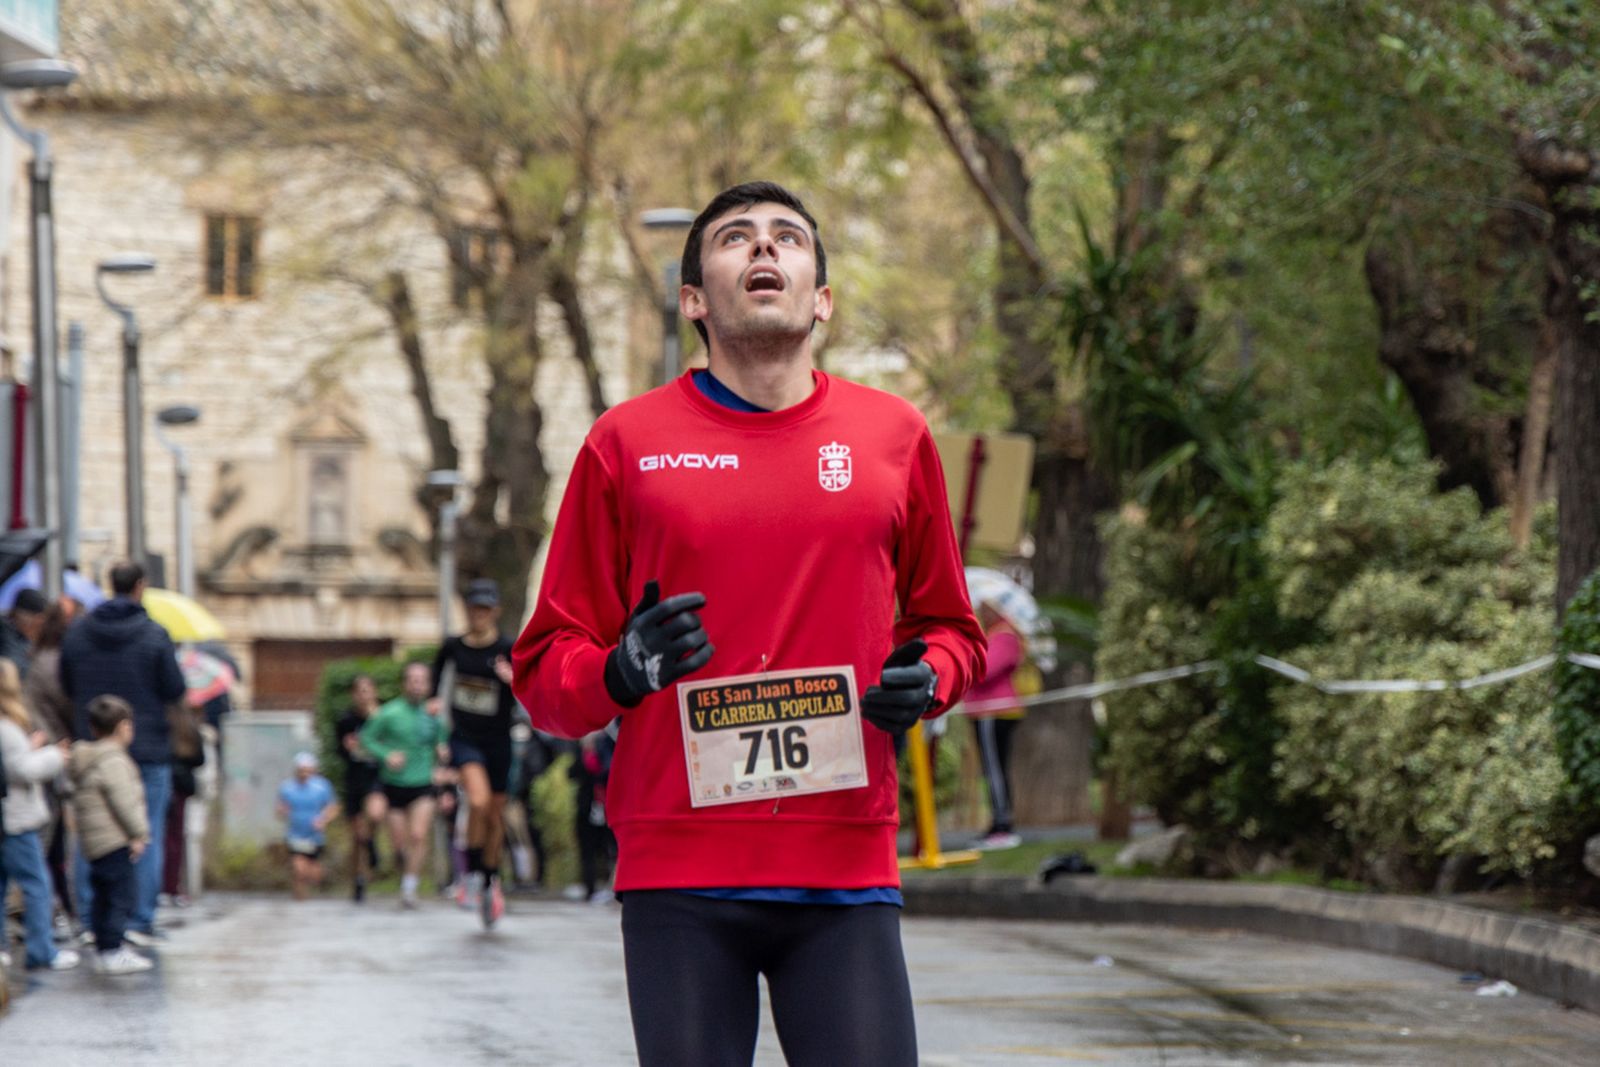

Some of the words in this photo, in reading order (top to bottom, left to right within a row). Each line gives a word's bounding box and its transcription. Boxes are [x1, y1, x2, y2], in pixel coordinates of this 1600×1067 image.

[639, 453, 739, 471] GIVOVA
[697, 690, 720, 707] IES
[724, 688, 751, 704] San
[756, 682, 791, 699] Juan
[794, 678, 838, 694] Bosco
[695, 711, 706, 728] V
[710, 702, 776, 727] CARRERA
[780, 694, 845, 718] POPULAR
[739, 725, 809, 775] 716
